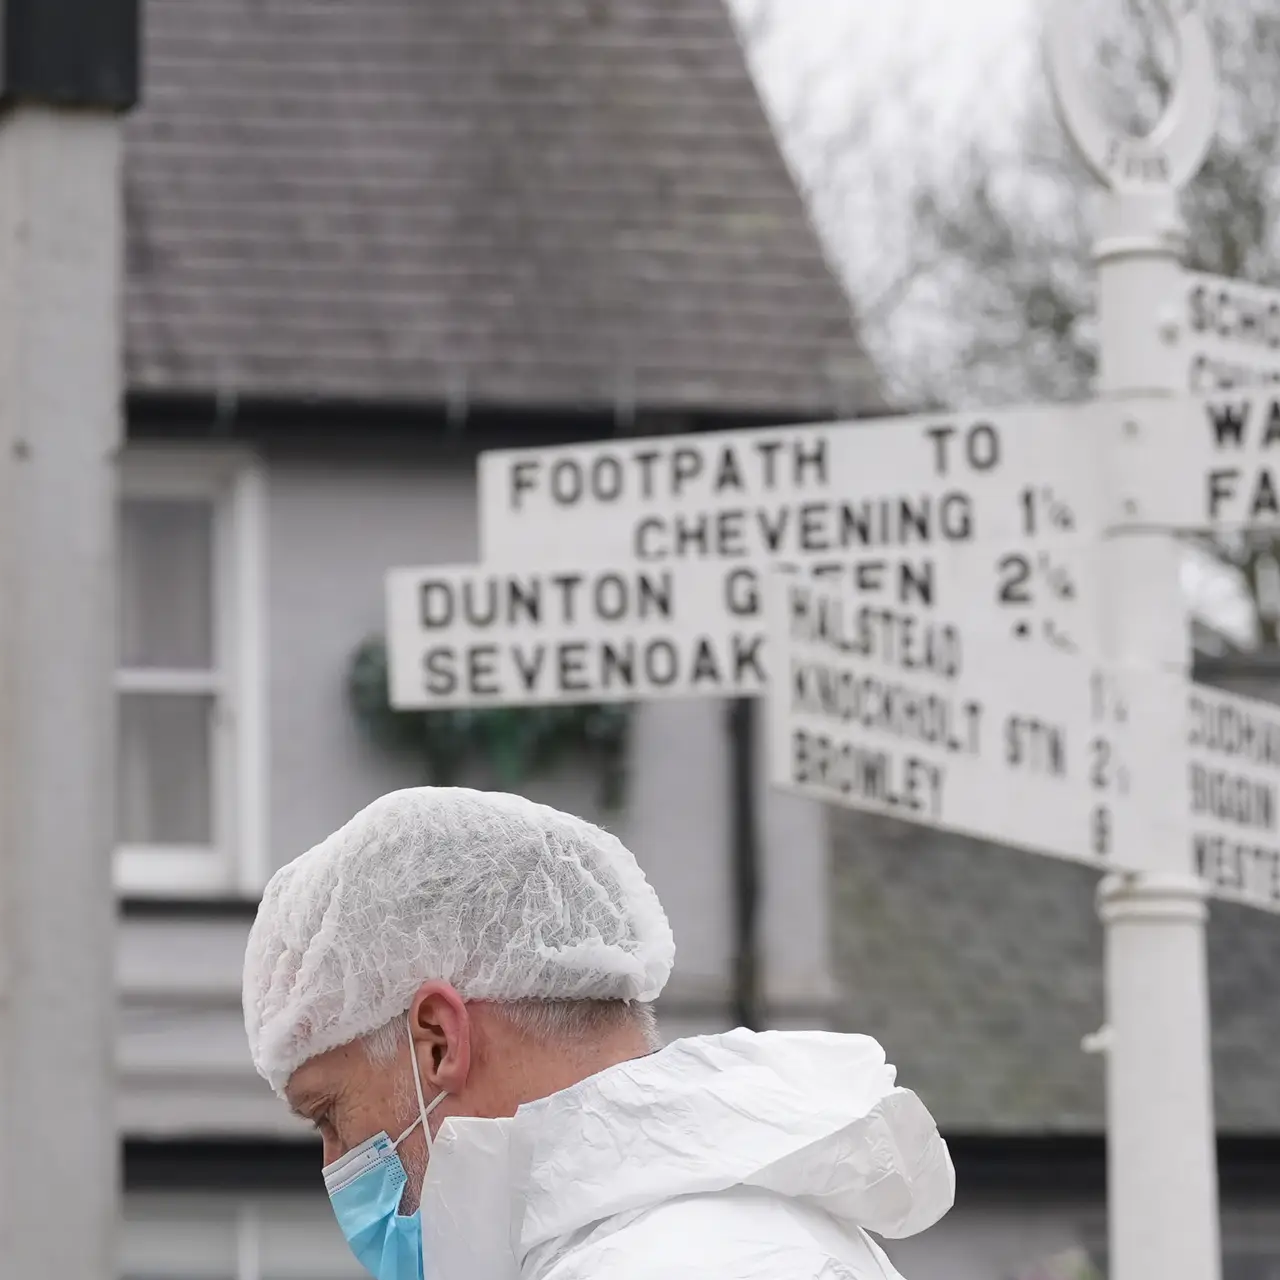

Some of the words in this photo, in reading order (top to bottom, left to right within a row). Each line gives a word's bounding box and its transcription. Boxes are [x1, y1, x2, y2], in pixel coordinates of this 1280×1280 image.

[510, 435, 829, 510] FOOTPATH
[928, 422, 1002, 478] TO
[633, 490, 973, 563] CHEVENING
[419, 569, 674, 631] DUNTON
[723, 557, 935, 618] GEN
[424, 634, 768, 698] SEVENOAK
